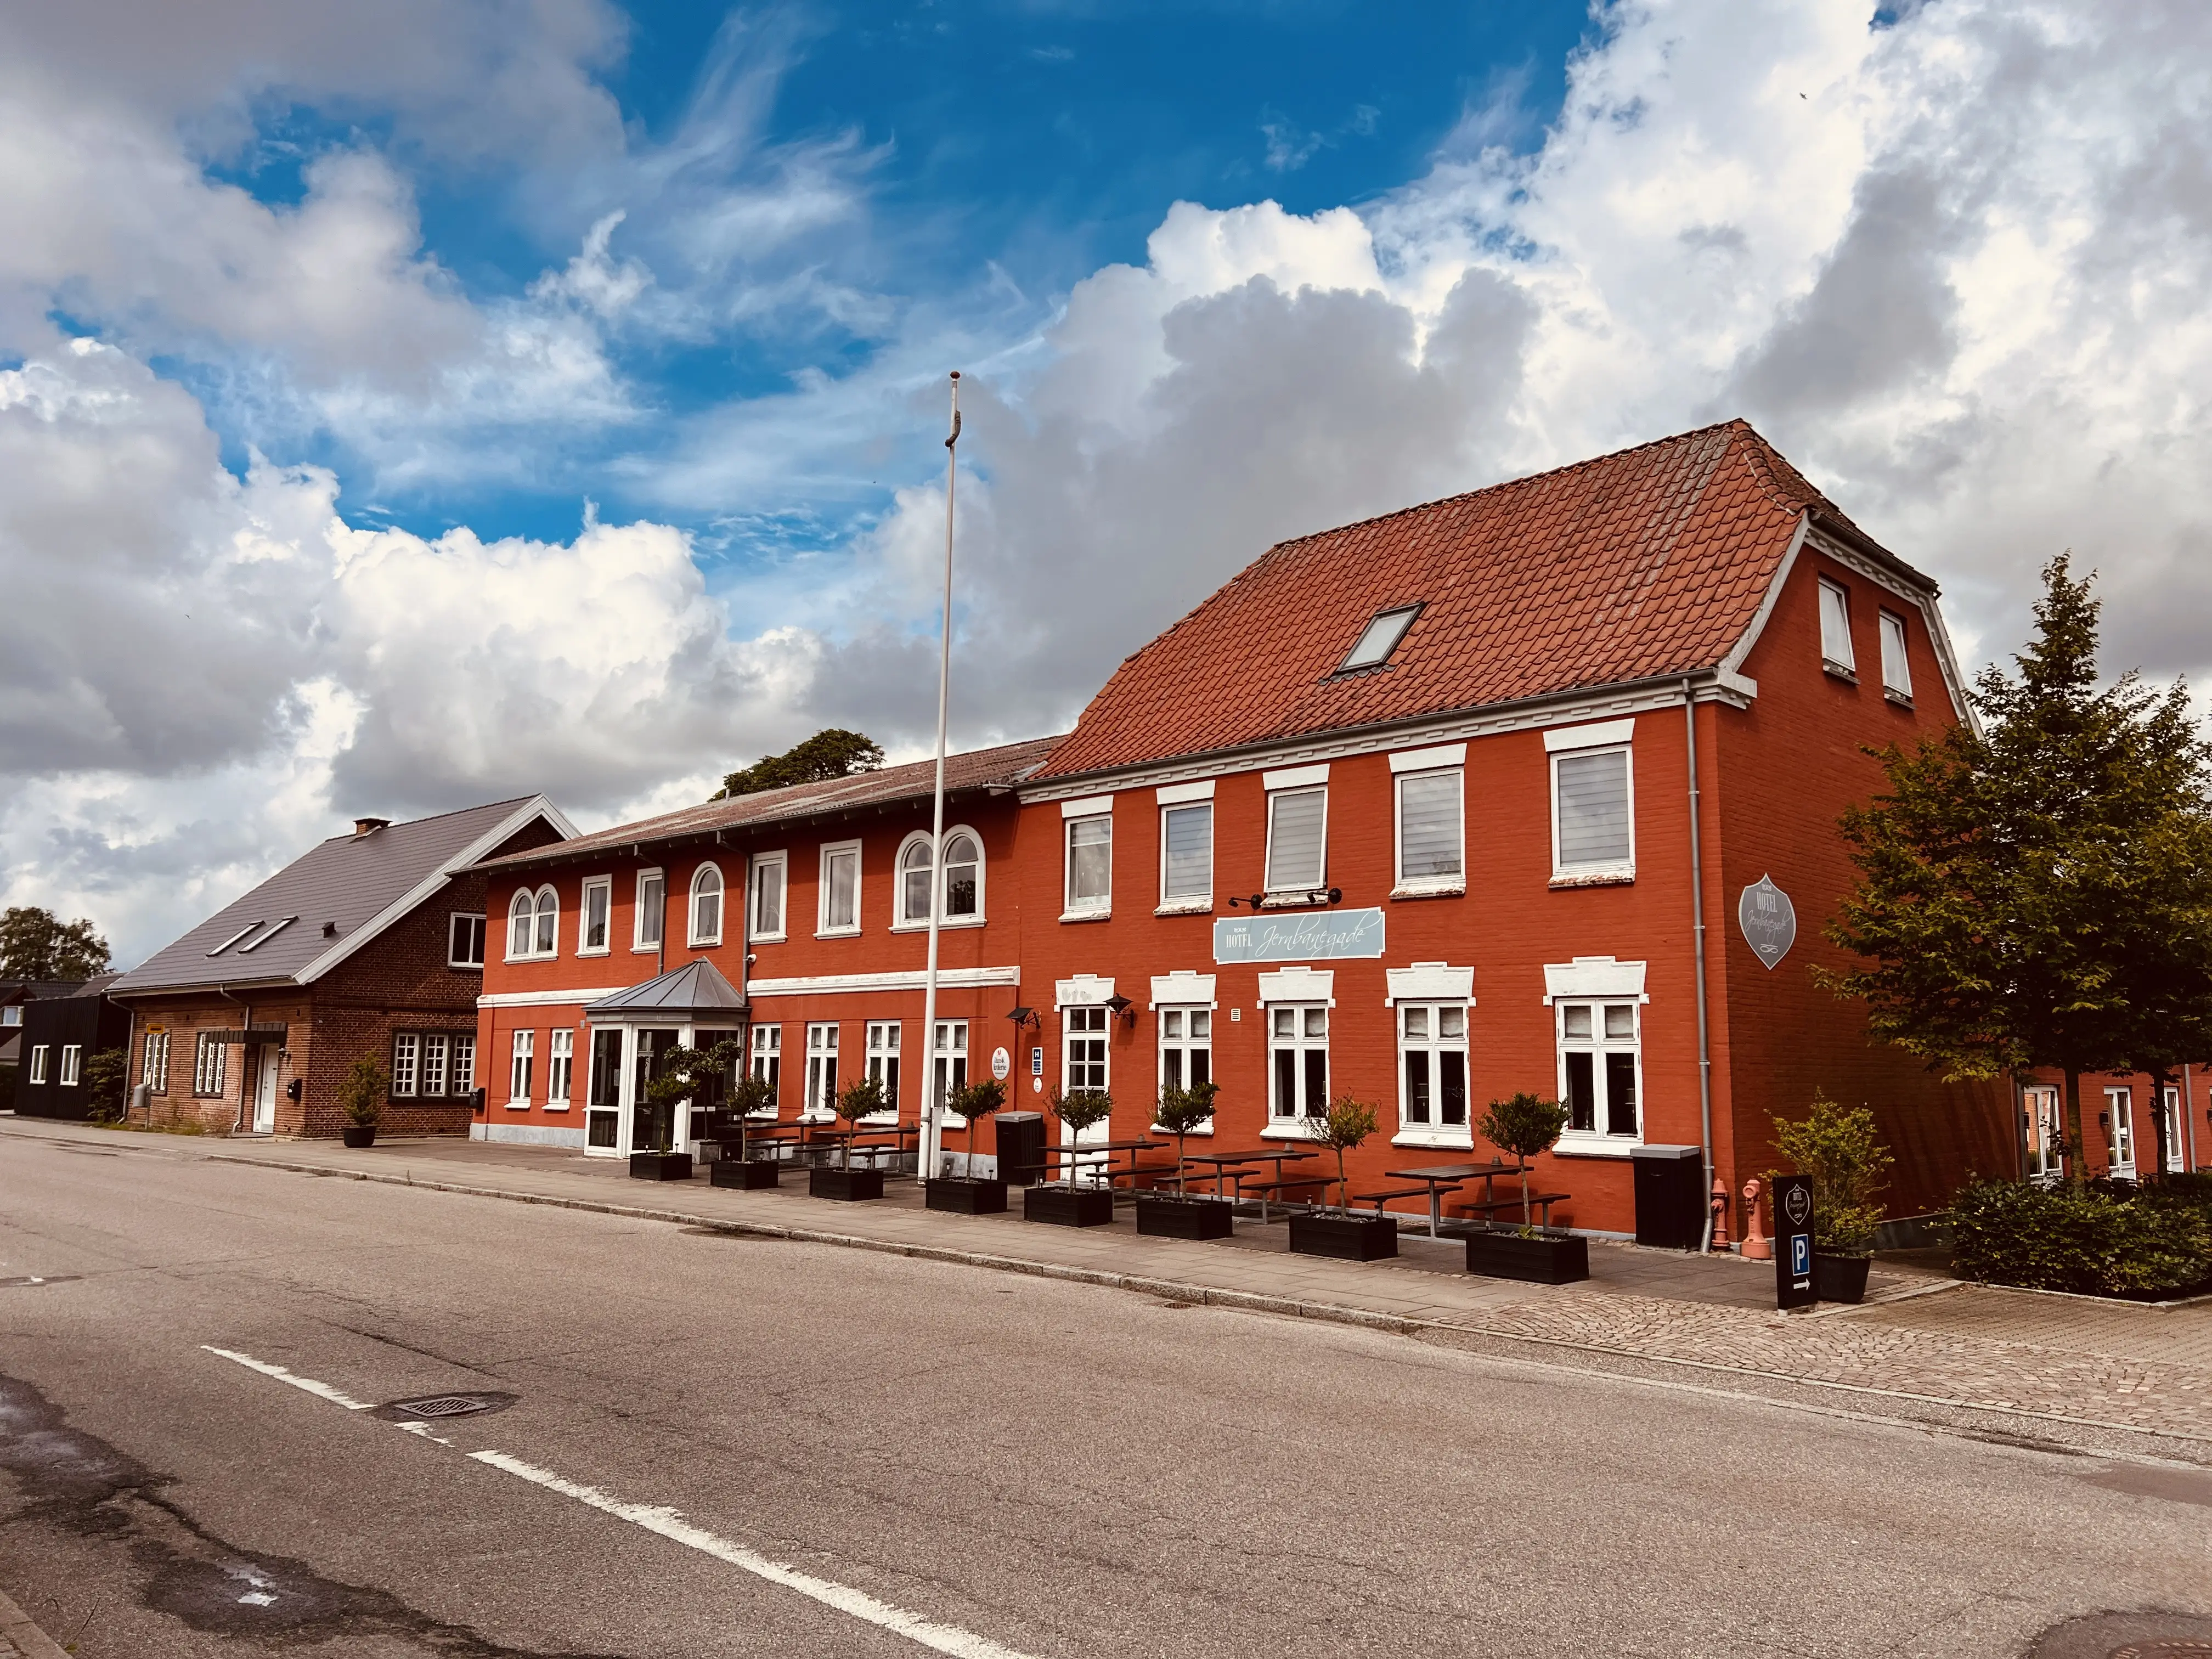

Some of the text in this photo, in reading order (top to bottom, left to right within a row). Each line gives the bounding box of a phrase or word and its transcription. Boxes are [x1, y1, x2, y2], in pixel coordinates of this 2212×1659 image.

[1757, 891, 1778, 913] HOTEL
[1226, 910, 1382, 958] HOTEL Jernbanegade
[1796, 1240, 1805, 1271] P
